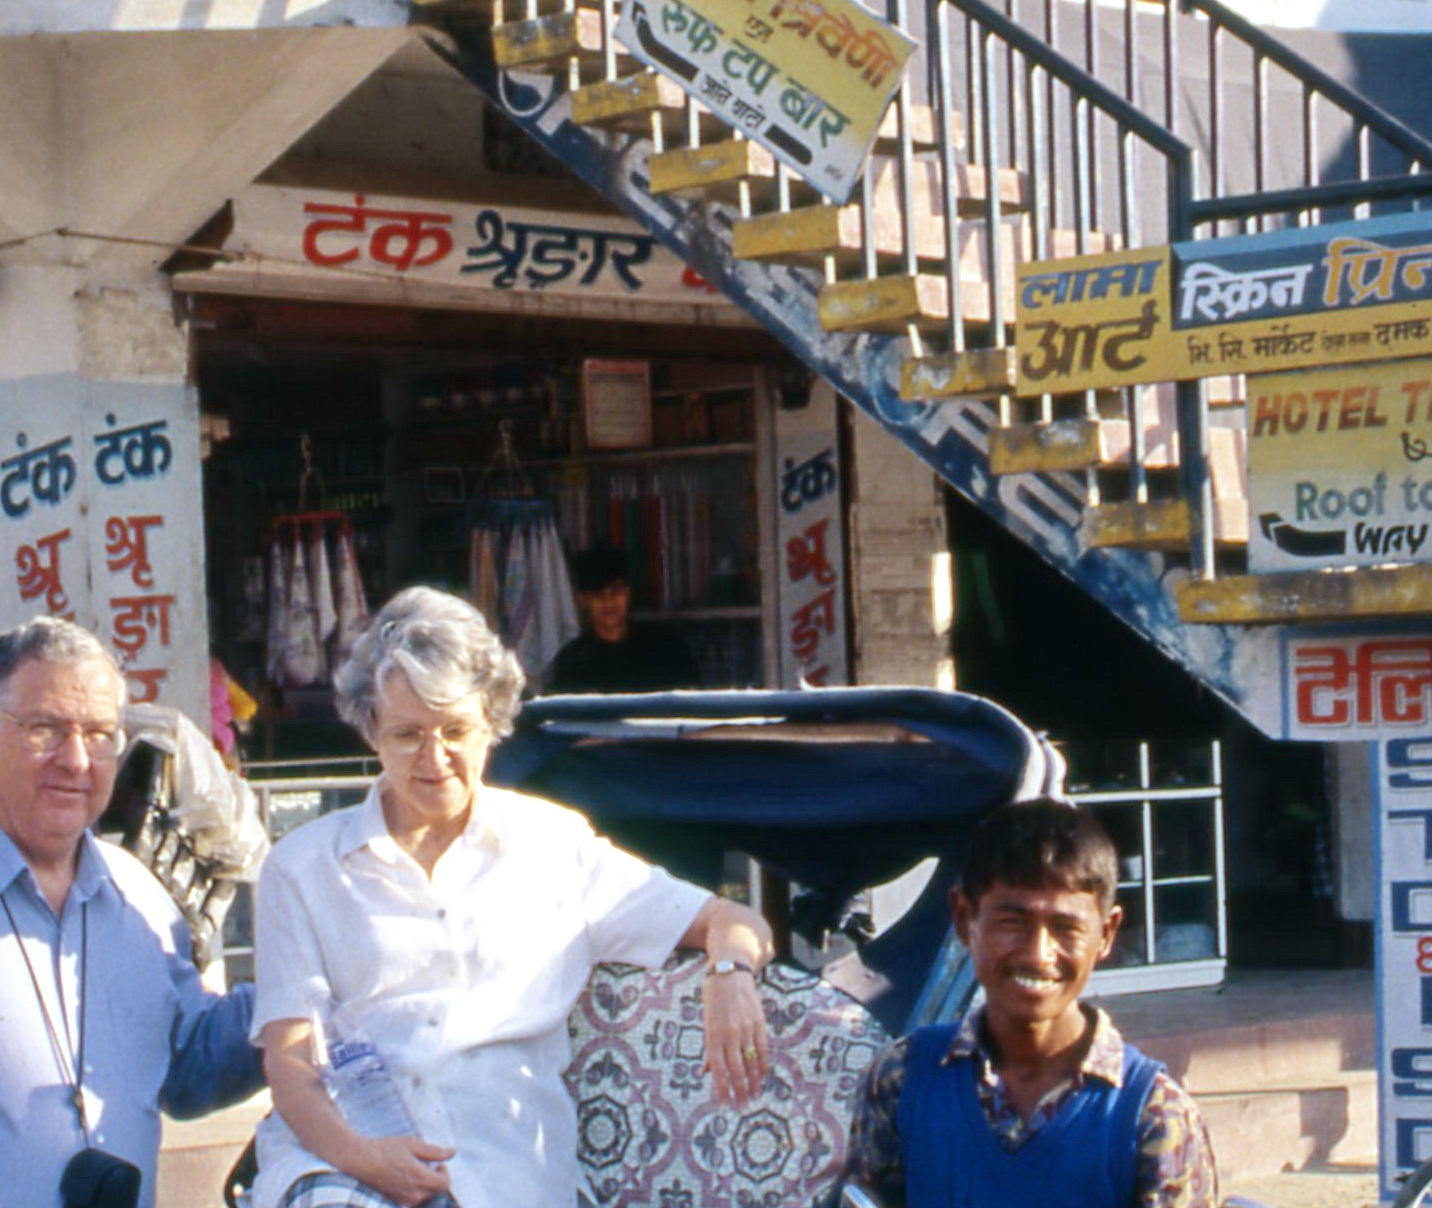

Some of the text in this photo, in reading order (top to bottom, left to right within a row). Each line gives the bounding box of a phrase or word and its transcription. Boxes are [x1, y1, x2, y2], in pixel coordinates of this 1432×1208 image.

[721, 37, 780, 97] टप
[779, 77, 852, 148] बार
[302, 193, 454, 271] टंक
[1018, 258, 1164, 309] लामा
[1180, 262, 1313, 321] स्क्रिन
[1020, 300, 1162, 381] आर्ट
[1252, 385, 1388, 437] HOTEL
[0, 431, 77, 518] टंक
[93, 412, 173, 487] टंक
[781, 447, 836, 513] टंक
[1295, 472, 1388, 522] Roof
[1353, 520, 1429, 556] WAY
